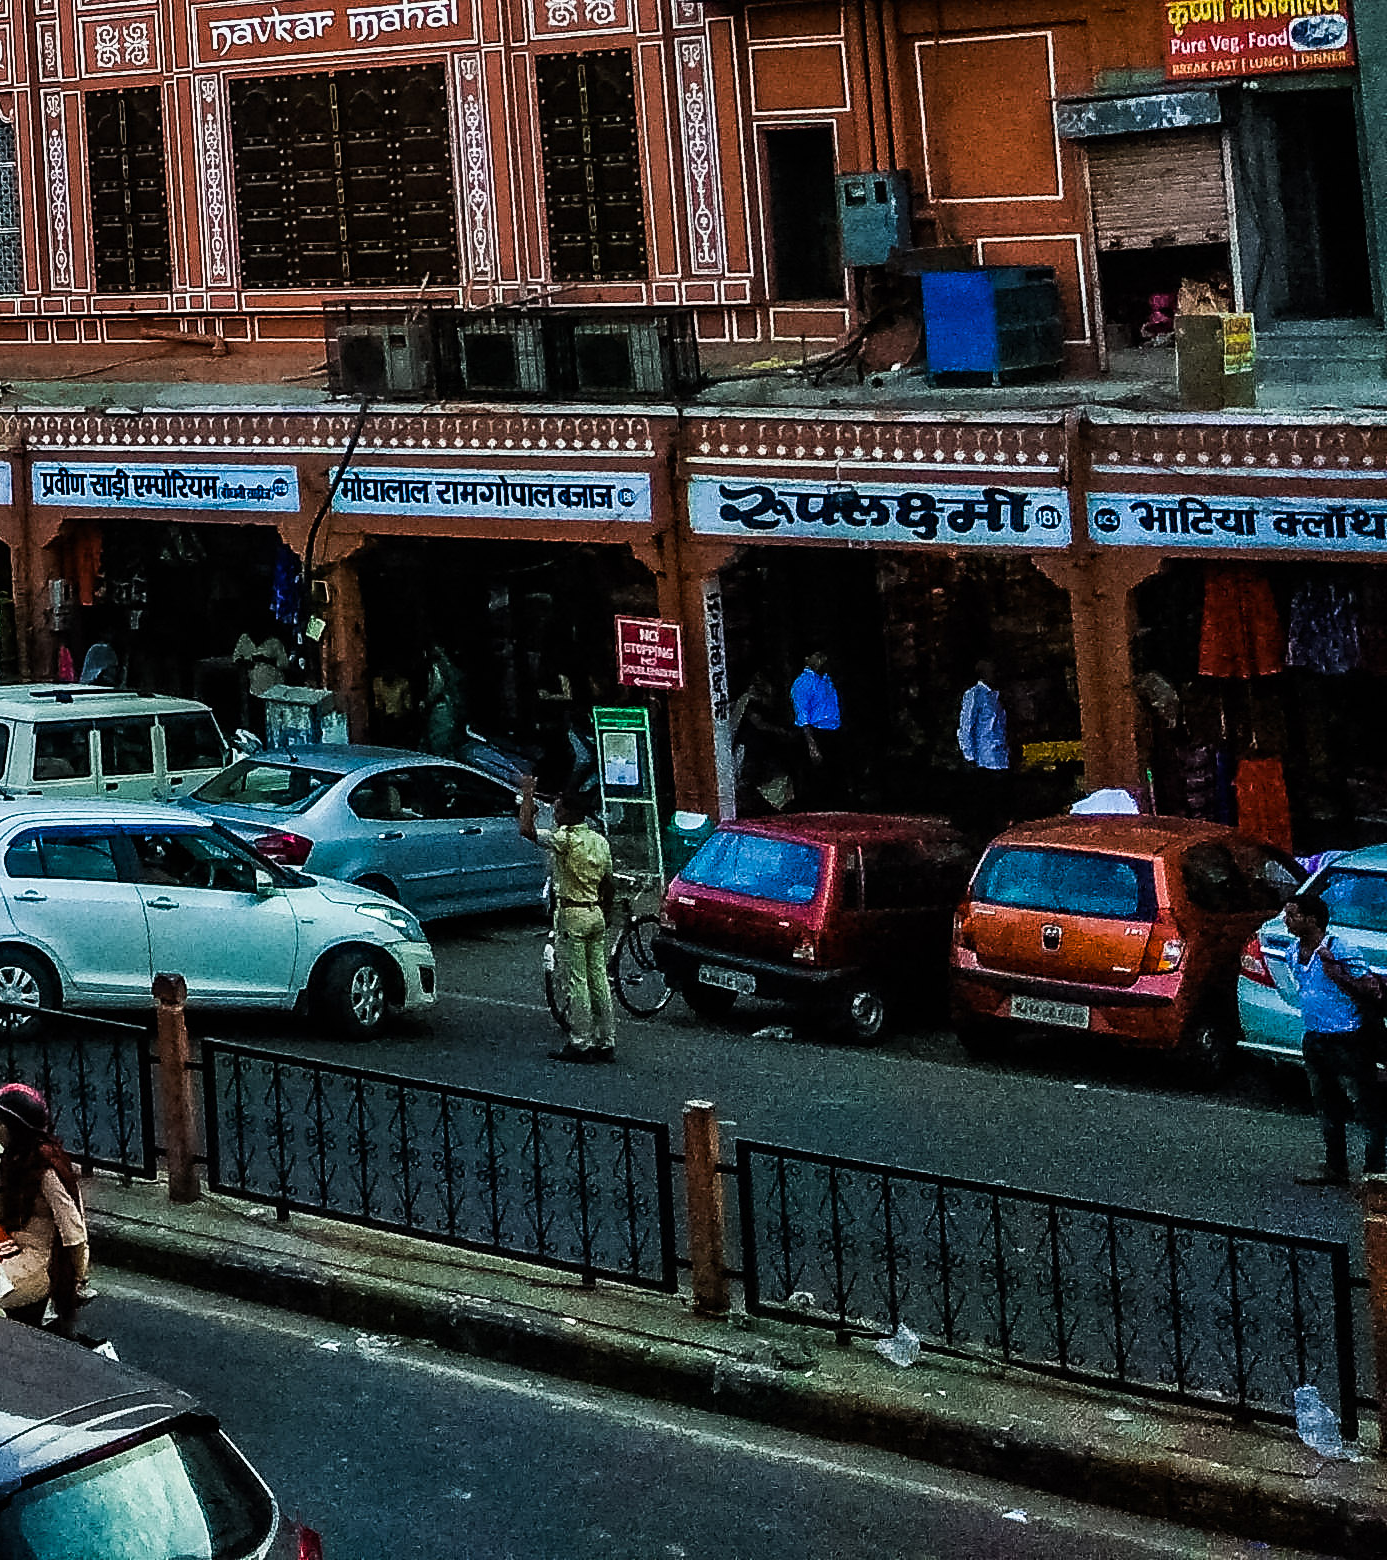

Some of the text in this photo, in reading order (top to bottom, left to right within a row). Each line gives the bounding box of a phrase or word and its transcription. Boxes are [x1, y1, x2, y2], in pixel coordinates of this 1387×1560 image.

[209, 7, 335, 56] navkar
[1170, 28, 1288, 55] Pure Veg. Food
[39, 467, 87, 498] प्रवीण
[131, 469, 219, 499] एम्पोरियम
[340, 474, 431, 504] मोघालाल
[435, 475, 554, 508] रामगोपाल
[555, 484, 615, 509] बजाज
[1036, 510, 1059, 526] 181
[1129, 497, 1259, 536] भाटिया
[639, 628, 659, 642] NO
